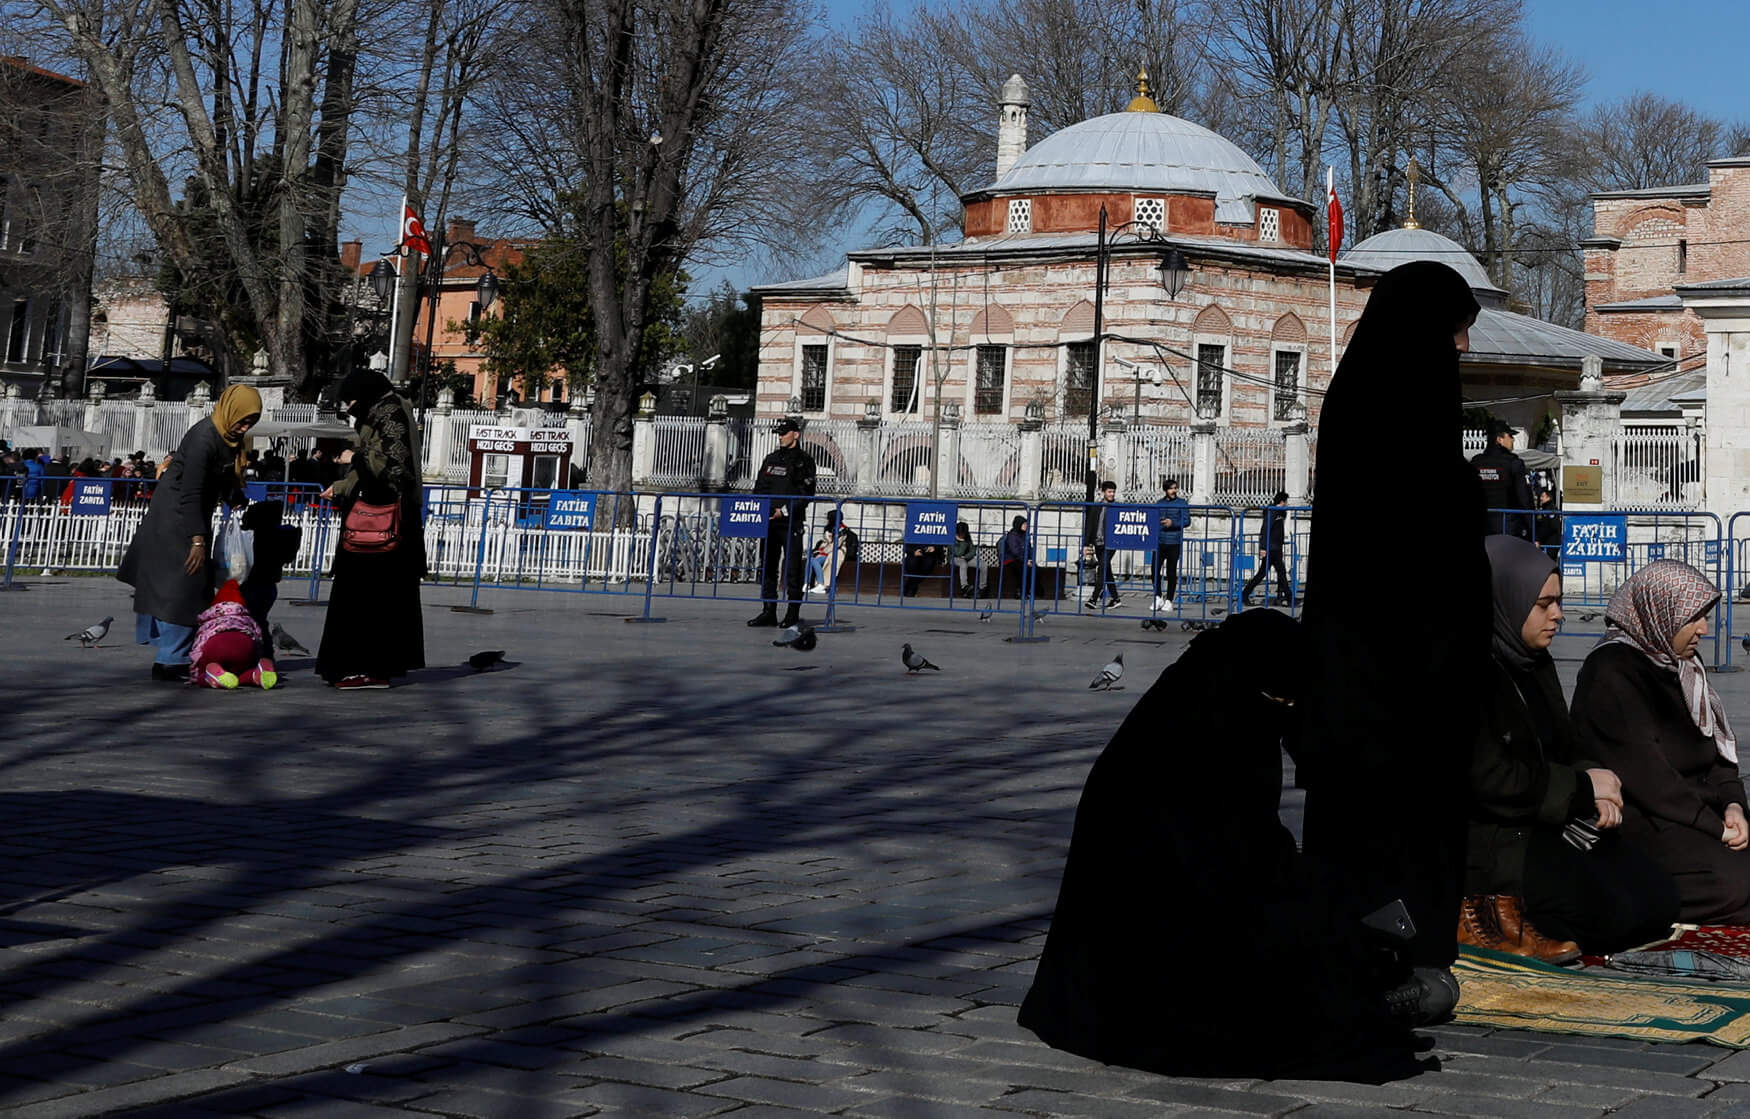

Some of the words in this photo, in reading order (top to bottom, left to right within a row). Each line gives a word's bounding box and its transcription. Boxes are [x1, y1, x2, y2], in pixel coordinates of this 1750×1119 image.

[476, 428, 492, 438] FAST
[494, 429, 517, 439] TRACK
[530, 431, 546, 440] FAST
[548, 431, 570, 440] TRACK
[556, 498, 589, 512] FATİH
[734, 500, 760, 511] FATİH
[550, 514, 589, 527] ZABITA
[918, 512, 946, 523] FATİH
[1119, 509, 1147, 523] FATİH
[914, 524, 948, 535] ZABITA
[1113, 524, 1149, 536] ZABITA
[1571, 521, 1617, 538] FATİH
[1566, 541, 1621, 556] ZABITA
